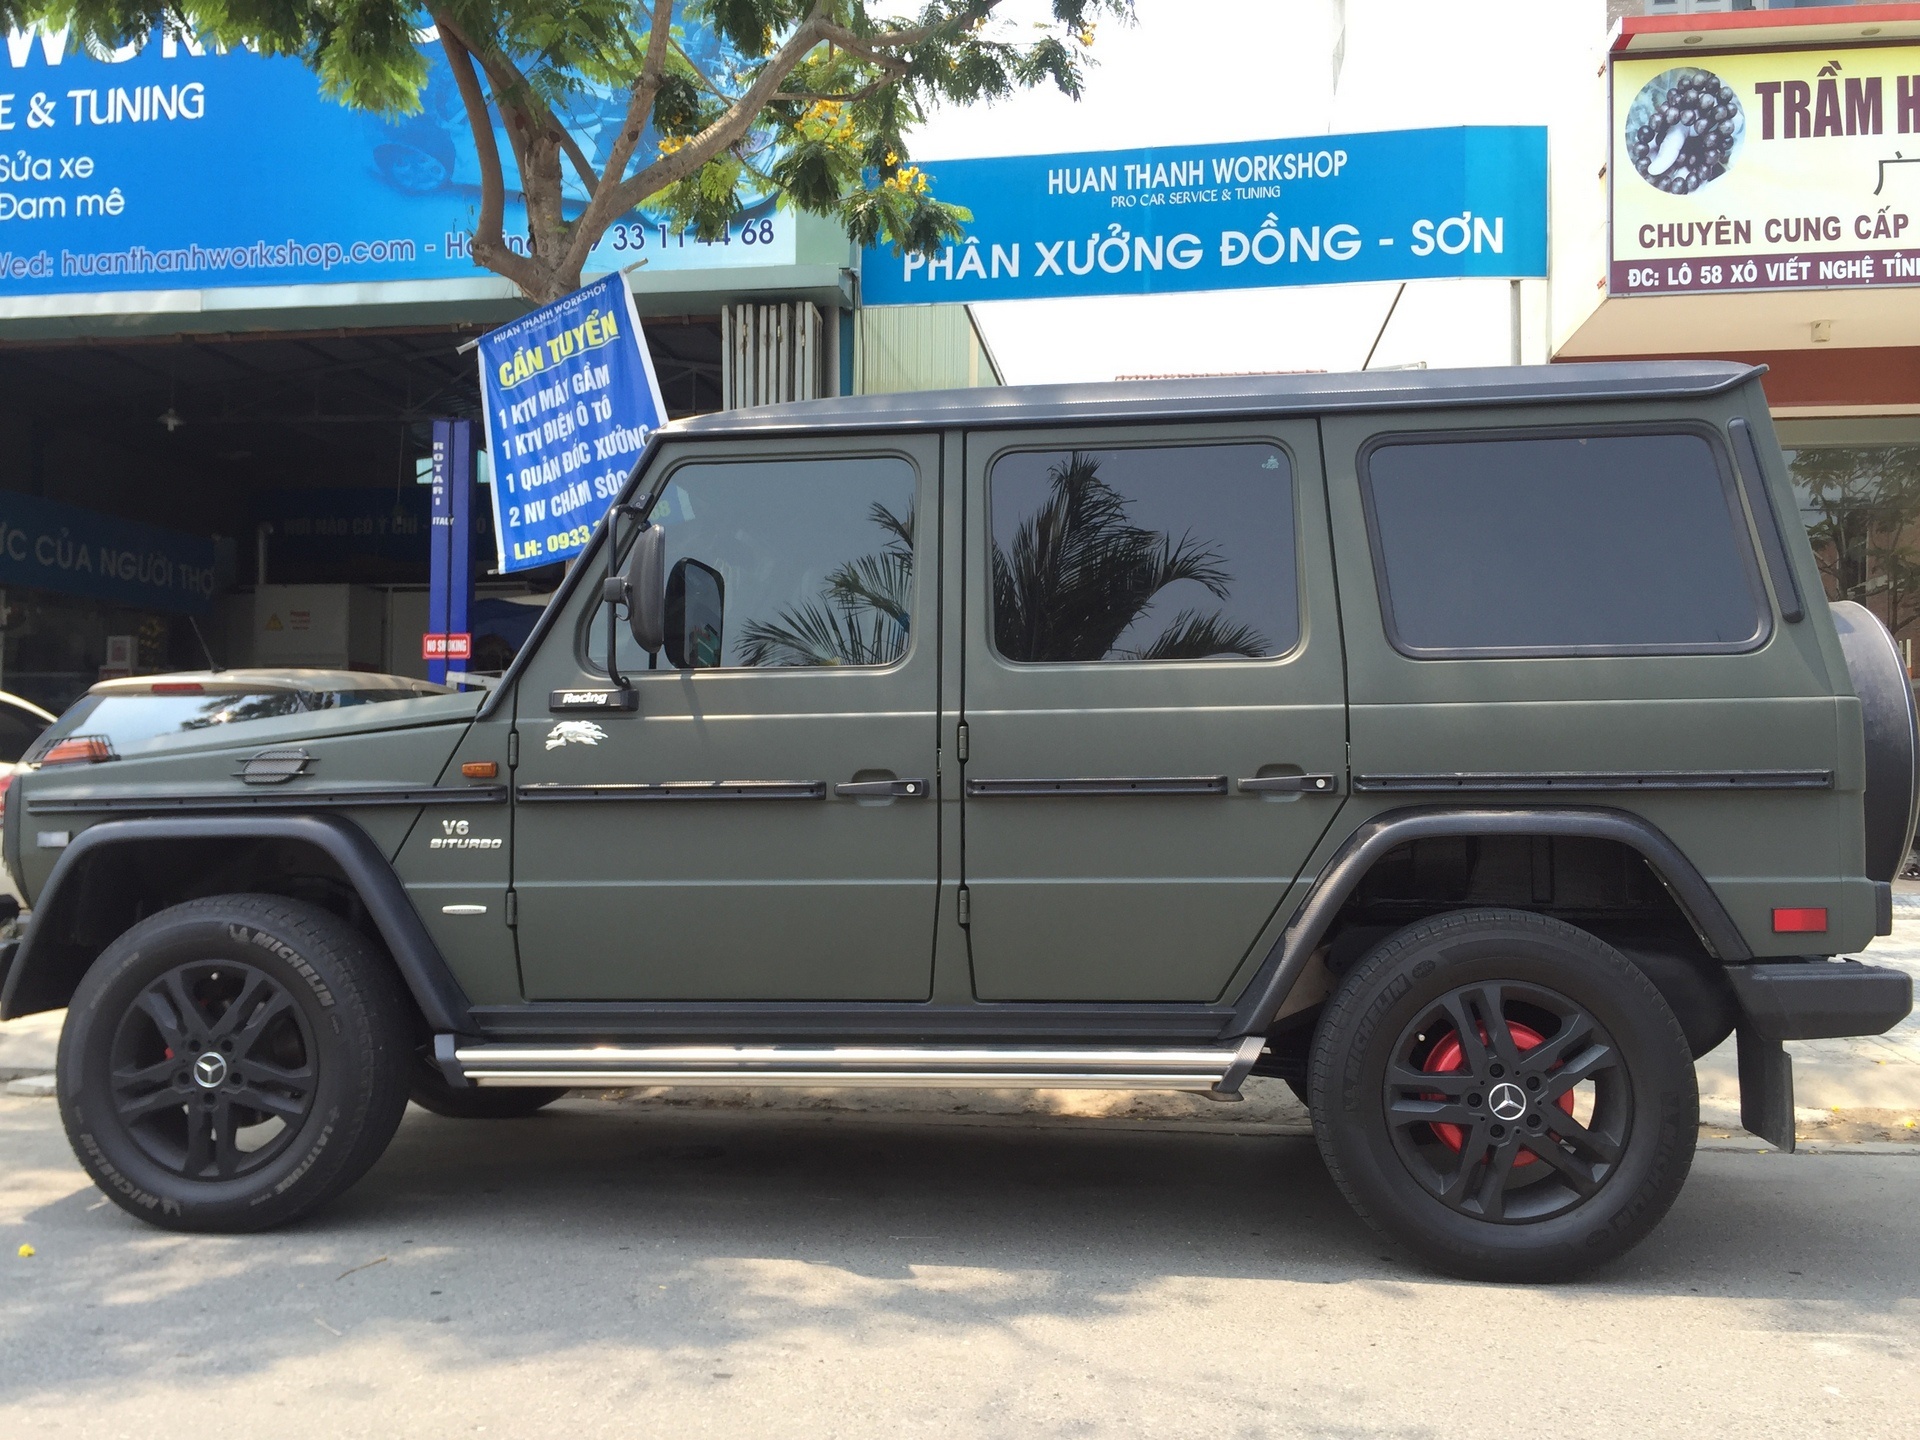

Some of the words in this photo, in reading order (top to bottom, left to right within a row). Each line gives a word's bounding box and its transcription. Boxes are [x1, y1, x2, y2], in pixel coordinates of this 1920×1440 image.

[26, 92, 57, 129] &
[67, 82, 205, 126] TUNING
[1754, 60, 1883, 141] TRẦM
[59, 156, 94, 179] xe
[1048, 165, 1117, 194] HUAN
[1124, 159, 1204, 190] THANH
[1211, 150, 1348, 185] WORKSHOP
[76, 187, 125, 216] mê
[1111, 194, 1137, 208] PRO
[1140, 192, 1166, 207] CAR
[1168, 190, 1218, 205] SERVICE
[1221, 188, 1232, 202] &
[1235, 186, 1281, 200] TUNING
[61, 237, 415, 278] huanthanhworkshop.com
[612, 224, 646, 252] 33
[741, 218, 775, 246] 68
[903, 236, 1020, 283] PHÂN
[1033, 222, 1204, 277] XƯỞNG
[1219, 211, 1363, 266] ĐỒNG
[1410, 212, 1503, 258] SƠN
[1638, 214, 1752, 249] CHUYÊN
[1764, 215, 1842, 244] CUNG
[1854, 205, 1910, 240] CẤP
[1628, 268, 1660, 287] ĐC:
[1667, 262, 1692, 285] LÔ
[1700, 265, 1723, 284] 58
[1730, 260, 1758, 283] XÔ
[1765, 256, 1812, 281] VIẾT
[1819, 255, 1875, 284] NGHỆ
[493, 325, 521, 344] HUAN
[520, 308, 554, 330] THANH
[554, 282, 608, 314] WORKSHOP
[499, 346, 545, 388] CẦN
[546, 309, 619, 364] TUYỂN
[498, 408, 508, 430] 1
[510, 395, 538, 425] KTV
[538, 378, 570, 412] MÁY
[572, 361, 610, 395] GẦM
[502, 439, 511, 460] 1
[515, 427, 543, 457] KTV
[543, 410, 576, 444] ĐIỆN
[576, 401, 589, 427] Ô
[591, 394, 612, 423] TÔ
[432, 441, 444, 506] ROTARI
[505, 473, 515, 494] 1
[520, 456, 562, 492] QUẢN
[562, 438, 591, 474] ĐỐC
[432, 516, 455, 527] ITALY
[508, 506, 521, 528] 2
[523, 499, 546, 525] NV
[551, 480, 593, 517] CHĂM
[34, 527, 94, 574] CỦA
[513, 539, 543, 561] LH:
[546, 525, 592, 553] 0933
[427, 640, 437, 652] NO
[562, 692, 608, 704] Racing
[430, 838, 503, 849] BITURBO
[442, 819, 470, 835] V6
[250, 931, 336, 1008] MICHELIN
